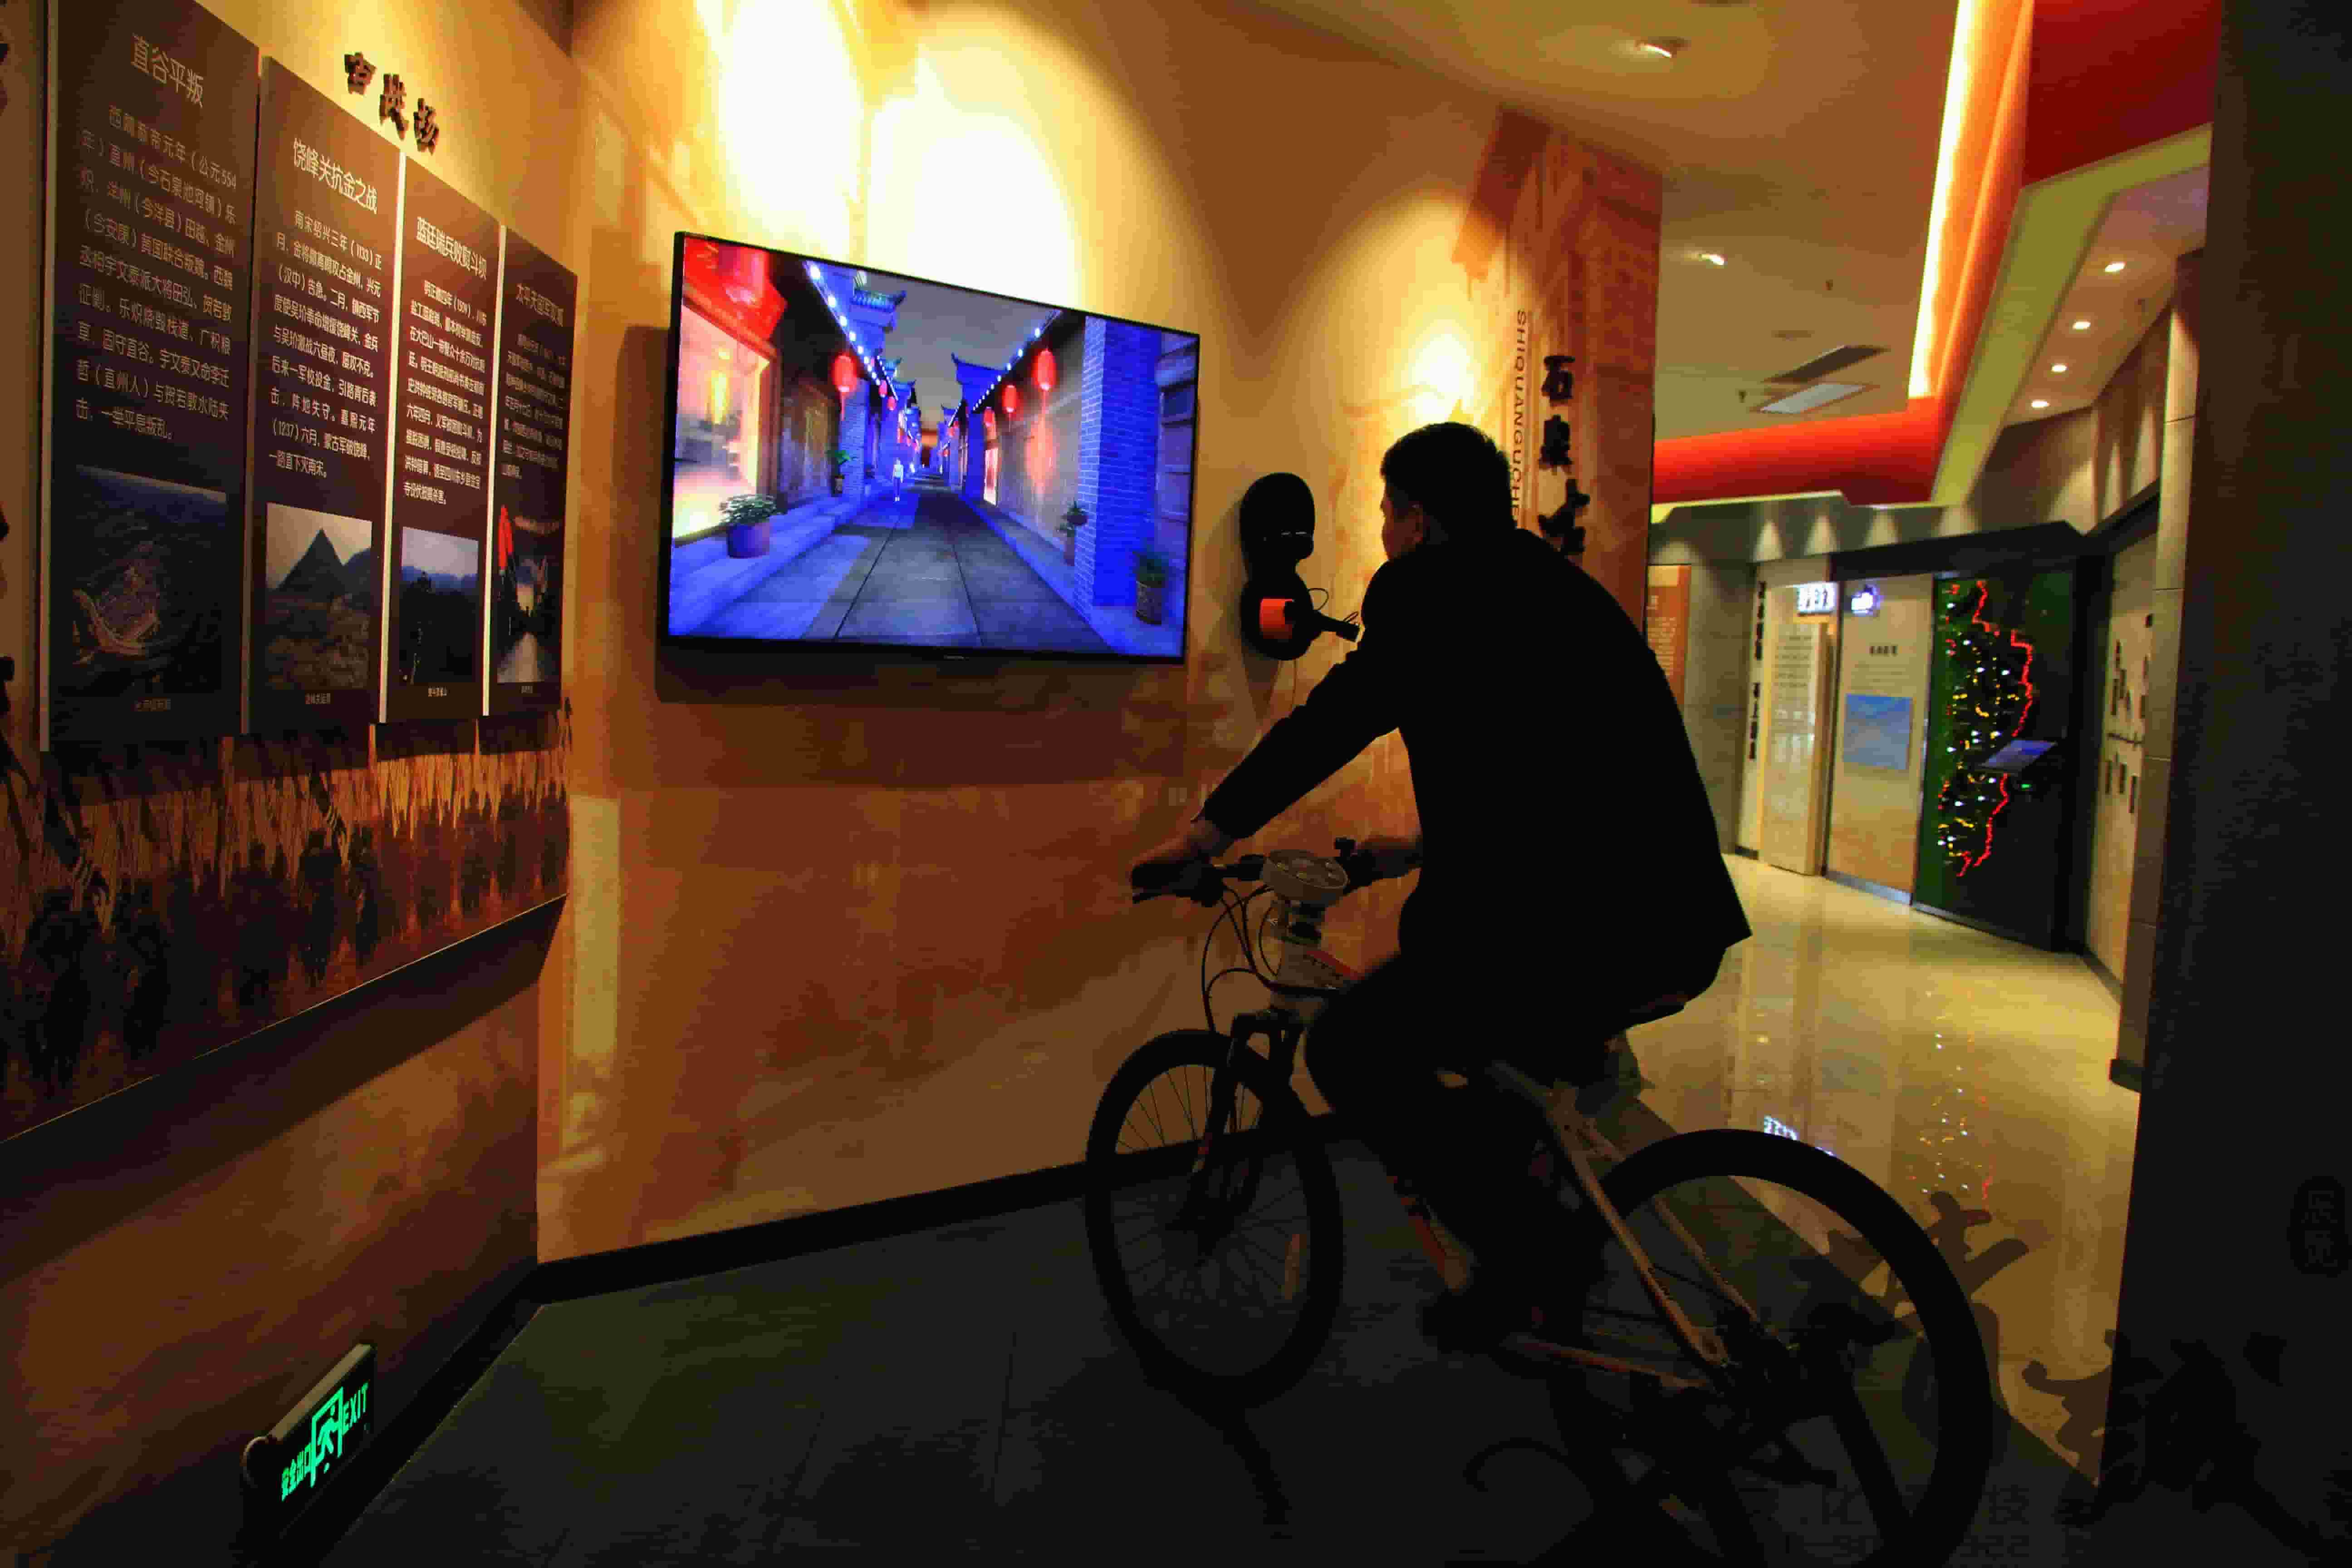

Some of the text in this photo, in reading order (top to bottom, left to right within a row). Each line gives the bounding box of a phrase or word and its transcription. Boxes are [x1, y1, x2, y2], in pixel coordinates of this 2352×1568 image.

[131, 32, 204, 109] 直谷平叛
[294, 137, 378, 215] 饶峰关抗金之战
[1511, 309, 1528, 522] SHIQUANGUCHE
[342, 1382, 368, 1436] EXIT
